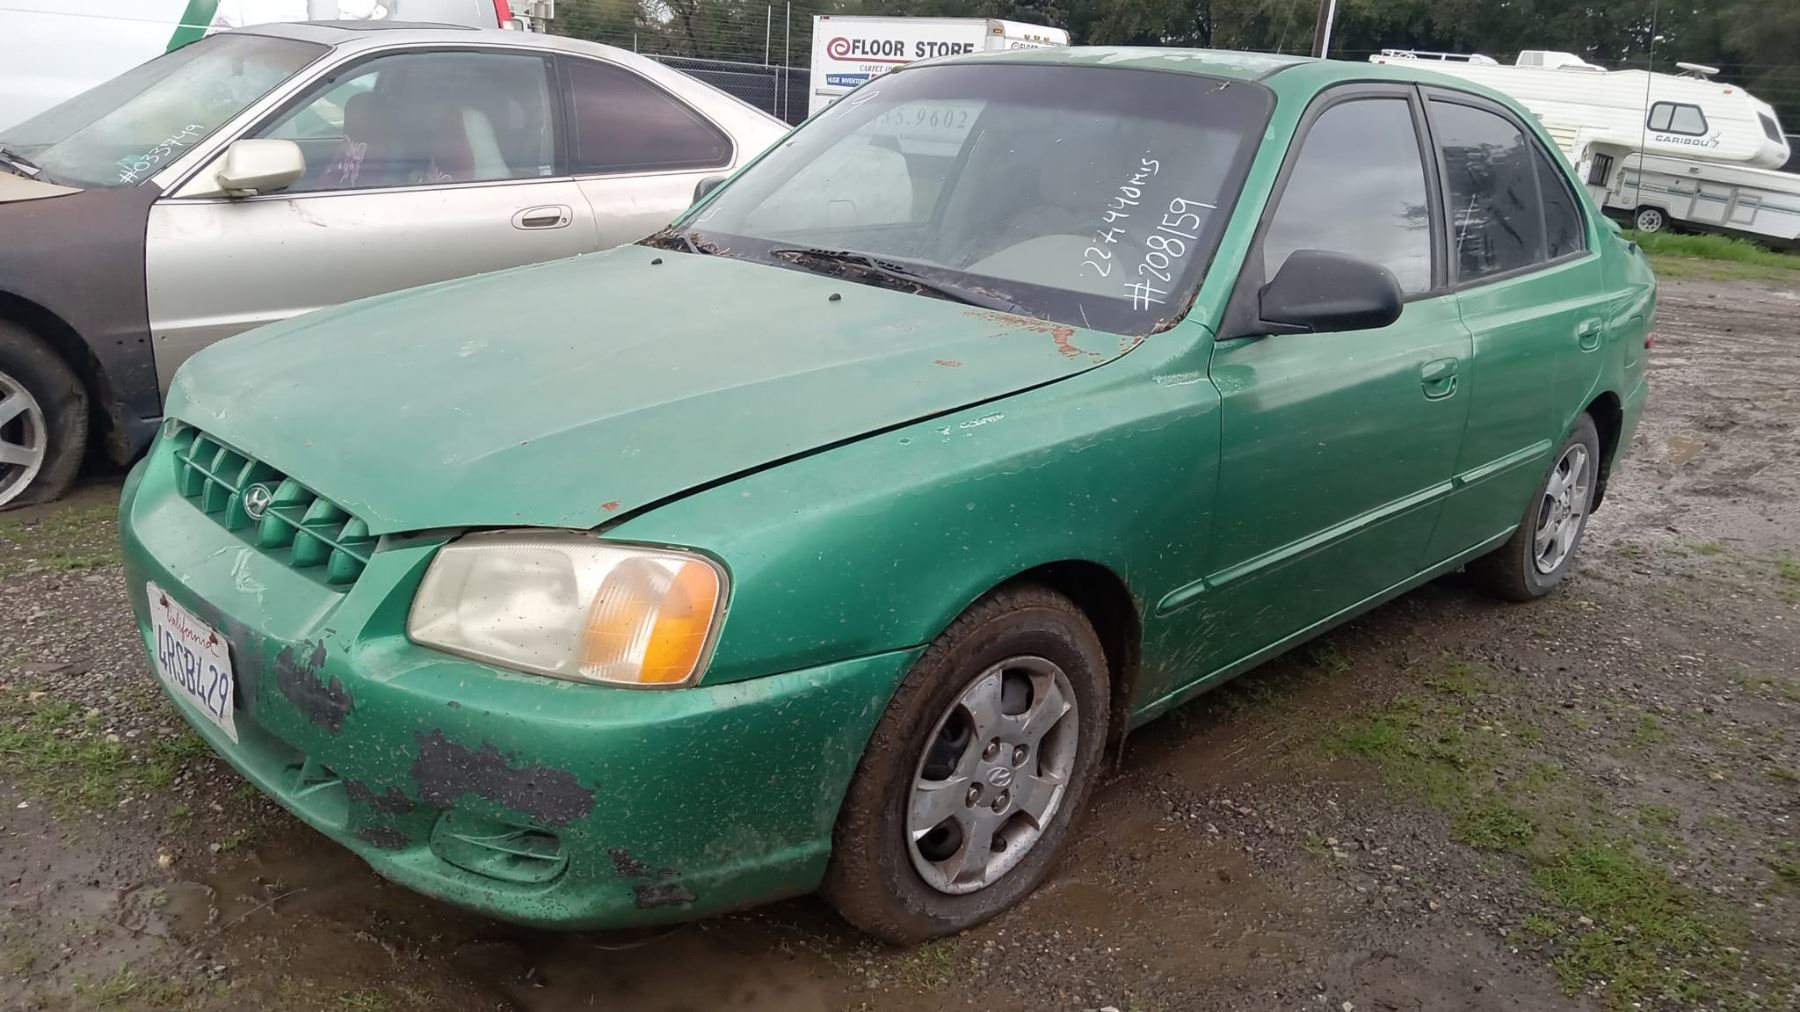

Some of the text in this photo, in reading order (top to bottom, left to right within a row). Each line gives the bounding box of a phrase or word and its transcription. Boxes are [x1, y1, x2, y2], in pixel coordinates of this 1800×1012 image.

[851, 39, 975, 58] FLOOR STORE
[859, 64, 883, 73] CARPET
[1655, 134, 1710, 147] CARIBOU
[1123, 197, 1218, 311] #208159
[166, 602, 220, 657] California
[158, 624, 229, 719] 4RSB429
